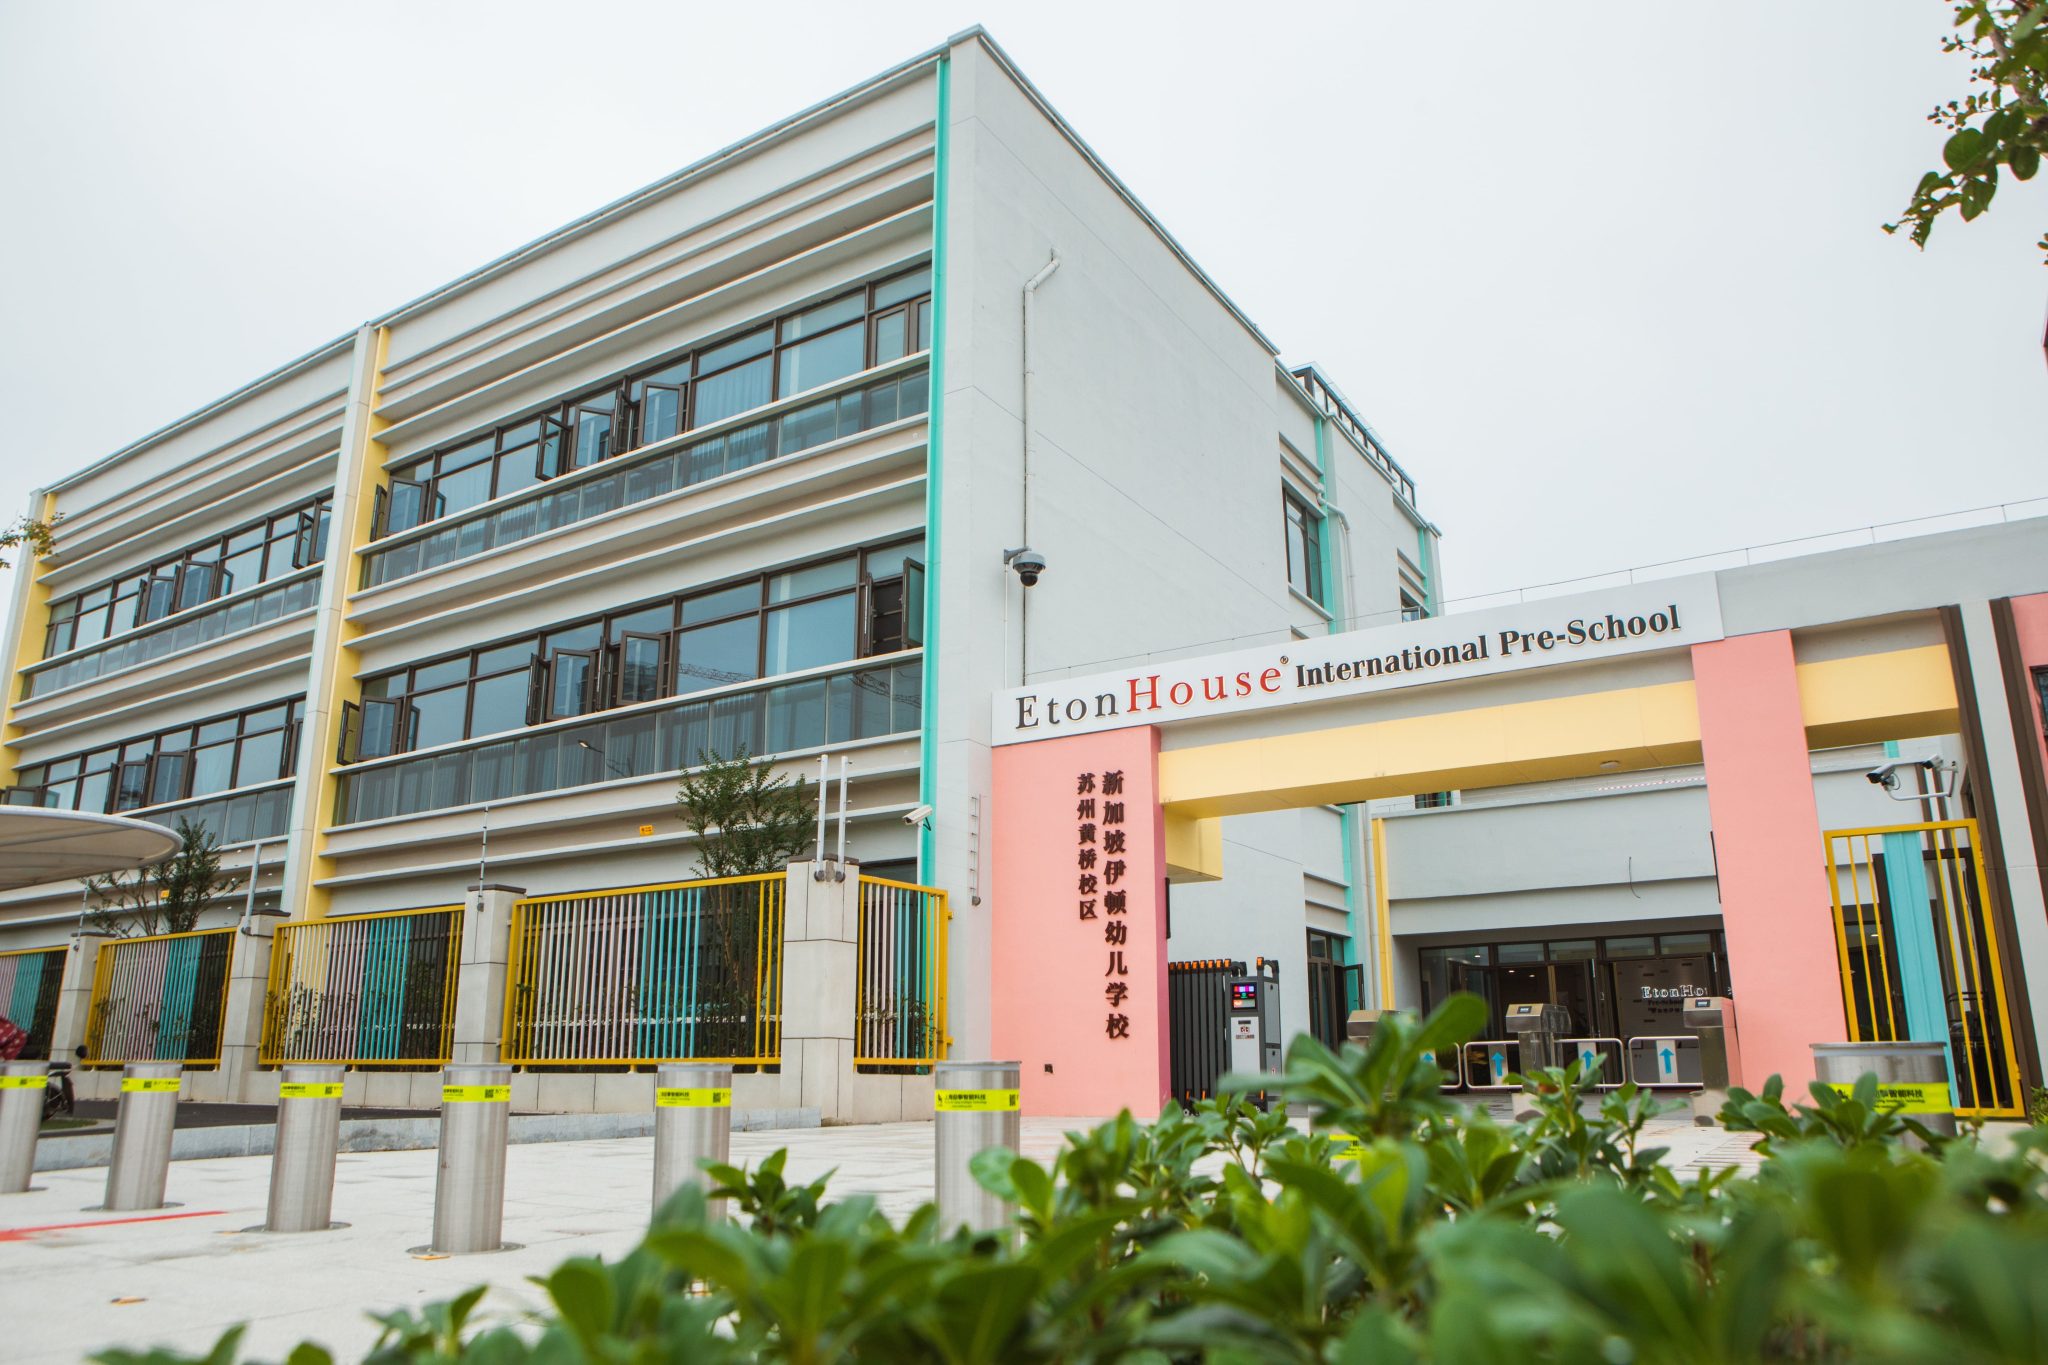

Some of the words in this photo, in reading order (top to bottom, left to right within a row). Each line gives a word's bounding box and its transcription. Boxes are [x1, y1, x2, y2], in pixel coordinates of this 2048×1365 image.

[1015, 666, 1282, 729] EtonHouse
[1296, 634, 1490, 689] International
[1499, 604, 1682, 657] Pre-School
[1077, 773, 1098, 921] 苏州黄桥校区
[1102, 770, 1130, 1040] 新加坡伊顿幼儿学校
